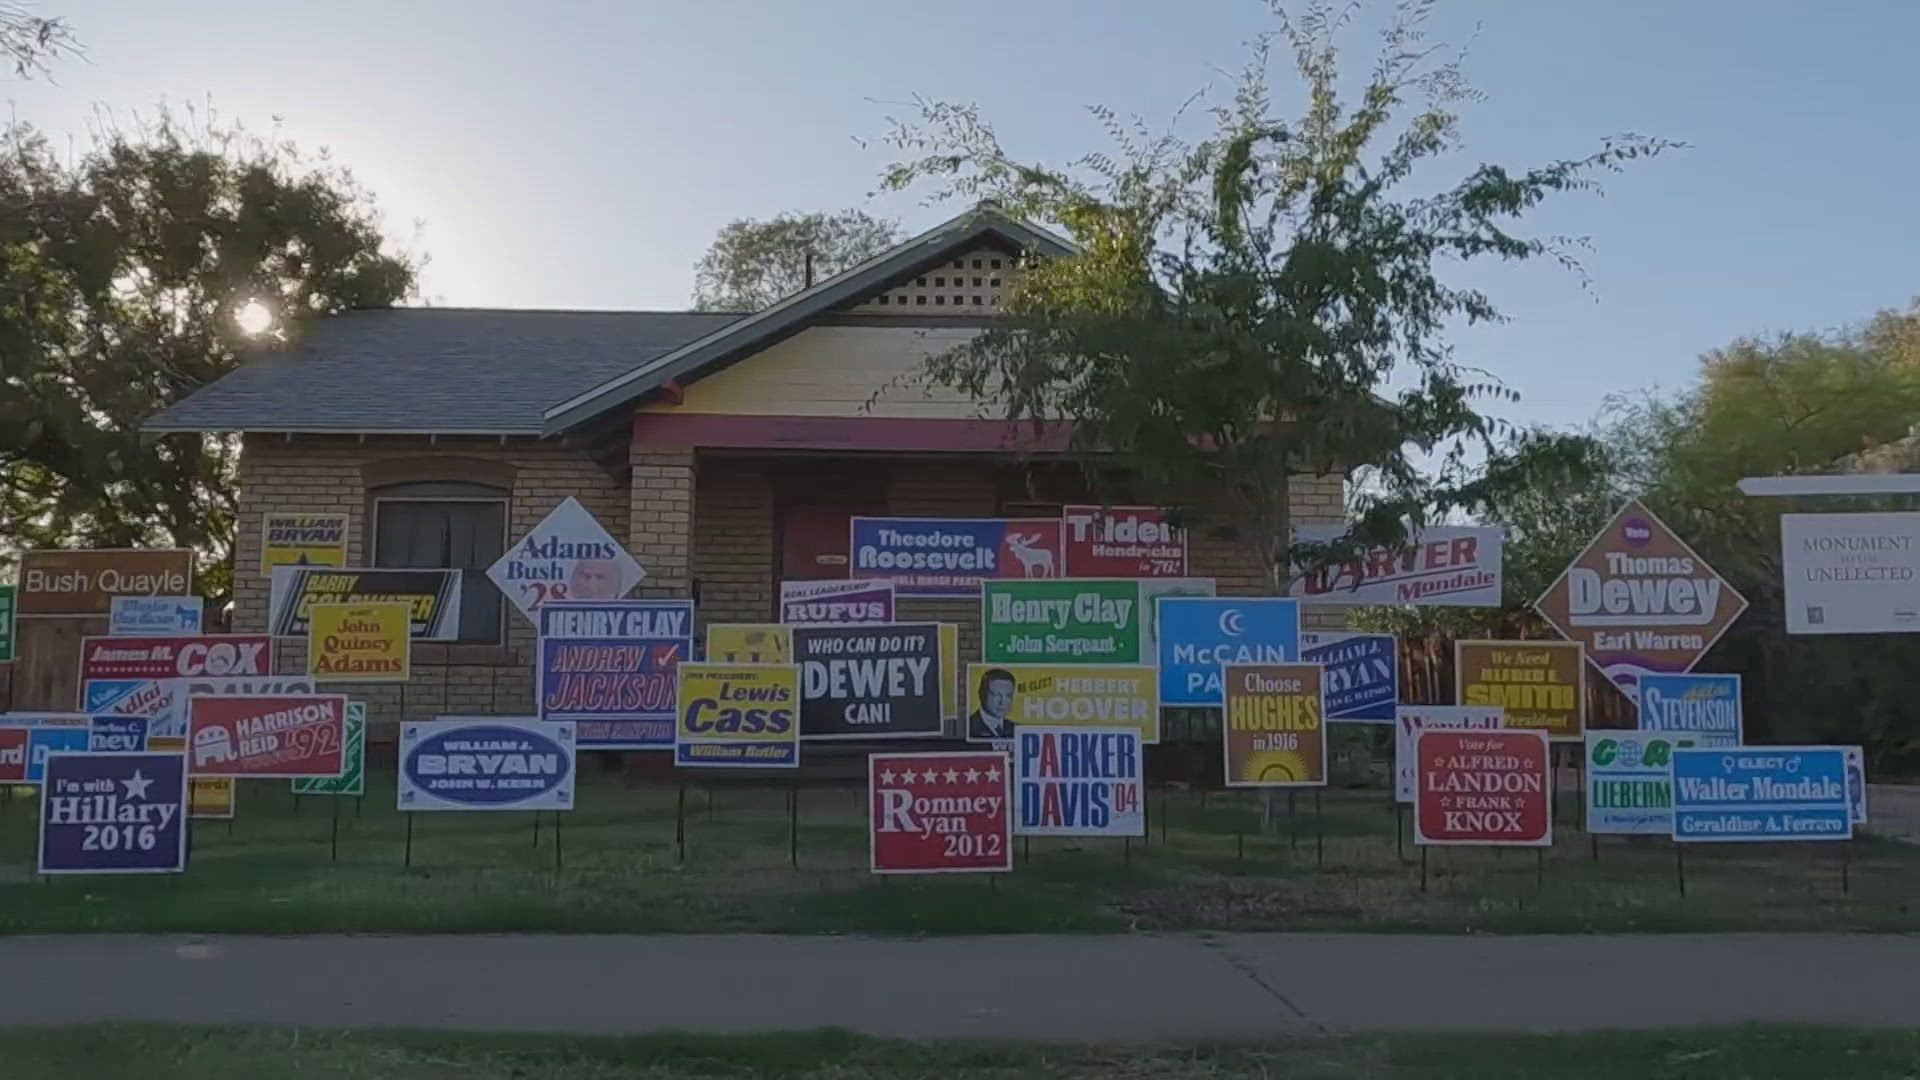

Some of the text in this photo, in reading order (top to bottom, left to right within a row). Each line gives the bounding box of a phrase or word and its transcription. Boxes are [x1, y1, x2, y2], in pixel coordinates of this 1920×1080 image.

[268, 519, 343, 528] WILLIAM
[1625, 528, 1649, 539] Vote
[268, 529, 343, 541] BRYAN
[878, 529, 975, 547] Theodore
[1803, 536, 1913, 551] MONUMENT
[519, 536, 616, 560] Adams
[858, 545, 995, 570] Roosevelt
[506, 561, 564, 580] Bush
[1605, 552, 1694, 575] Thomas
[306, 575, 360, 591] BARRY
[1806, 567, 1913, 581] UNELECTED
[1397, 571, 1495, 600] Mondale
[1568, 567, 1721, 625] Dewey
[786, 601, 885, 620] RUFUS
[991, 593, 1133, 629] Henry Clay
[336, 619, 380, 633] John
[548, 610, 685, 637] HENRY CLAY
[323, 635, 394, 654] Quincy
[808, 635, 926, 654] WHO CAN DO IT?
[1006, 634, 1116, 656] John Sergeant
[1594, 631, 1703, 650] Earl Warren
[88, 646, 149, 662] James
[176, 642, 267, 676] COX
[315, 654, 402, 673] Adams
[551, 645, 647, 672] ANDREW
[1173, 643, 1285, 664] McCAIN
[1491, 651, 1551, 665] We Need
[803, 657, 931, 699] DEWEY
[1055, 678, 1141, 693] HERBERT
[1245, 672, 1301, 691] Choose
[546, 673, 677, 711] JACKSON
[720, 681, 791, 702] Lewis
[1466, 684, 1575, 709] SMITH
[685, 697, 793, 734] Cass
[1022, 697, 1148, 719] HOOVER
[1230, 695, 1318, 730] HUGHES
[1646, 686, 1736, 731] STEVENSON
[235, 701, 335, 737] HARRISON
[238, 735, 278, 756] REID
[443, 741, 533, 751] WILLIAM J.
[690, 745, 743, 757] William
[1253, 733, 1298, 751] in 1916
[1459, 738, 1504, 752] Vote for
[417, 754, 558, 774] BRYAN
[1021, 733, 1136, 778] PARKER
[1447, 755, 1520, 769] ALFRED
[1737, 757, 1785, 770] ELECT
[56, 777, 115, 793] I'm with
[428, 779, 545, 788] JOHN W. KERN
[1427, 772, 1542, 792] LANDON
[1677, 776, 1842, 800] Walter Mondale
[48, 794, 178, 831] Hillary
[877, 788, 1002, 832] Romney
[1021, 782, 1109, 828] DAVIS
[1456, 796, 1512, 809] FRANK
[1443, 811, 1523, 832] KNOX
[1681, 815, 1761, 833] Geraldine
[1765, 815, 1782, 832] A.
[1782, 815, 1842, 833] Ferraro
[82, 824, 156, 851] 2016
[943, 834, 1001, 857] 2012
